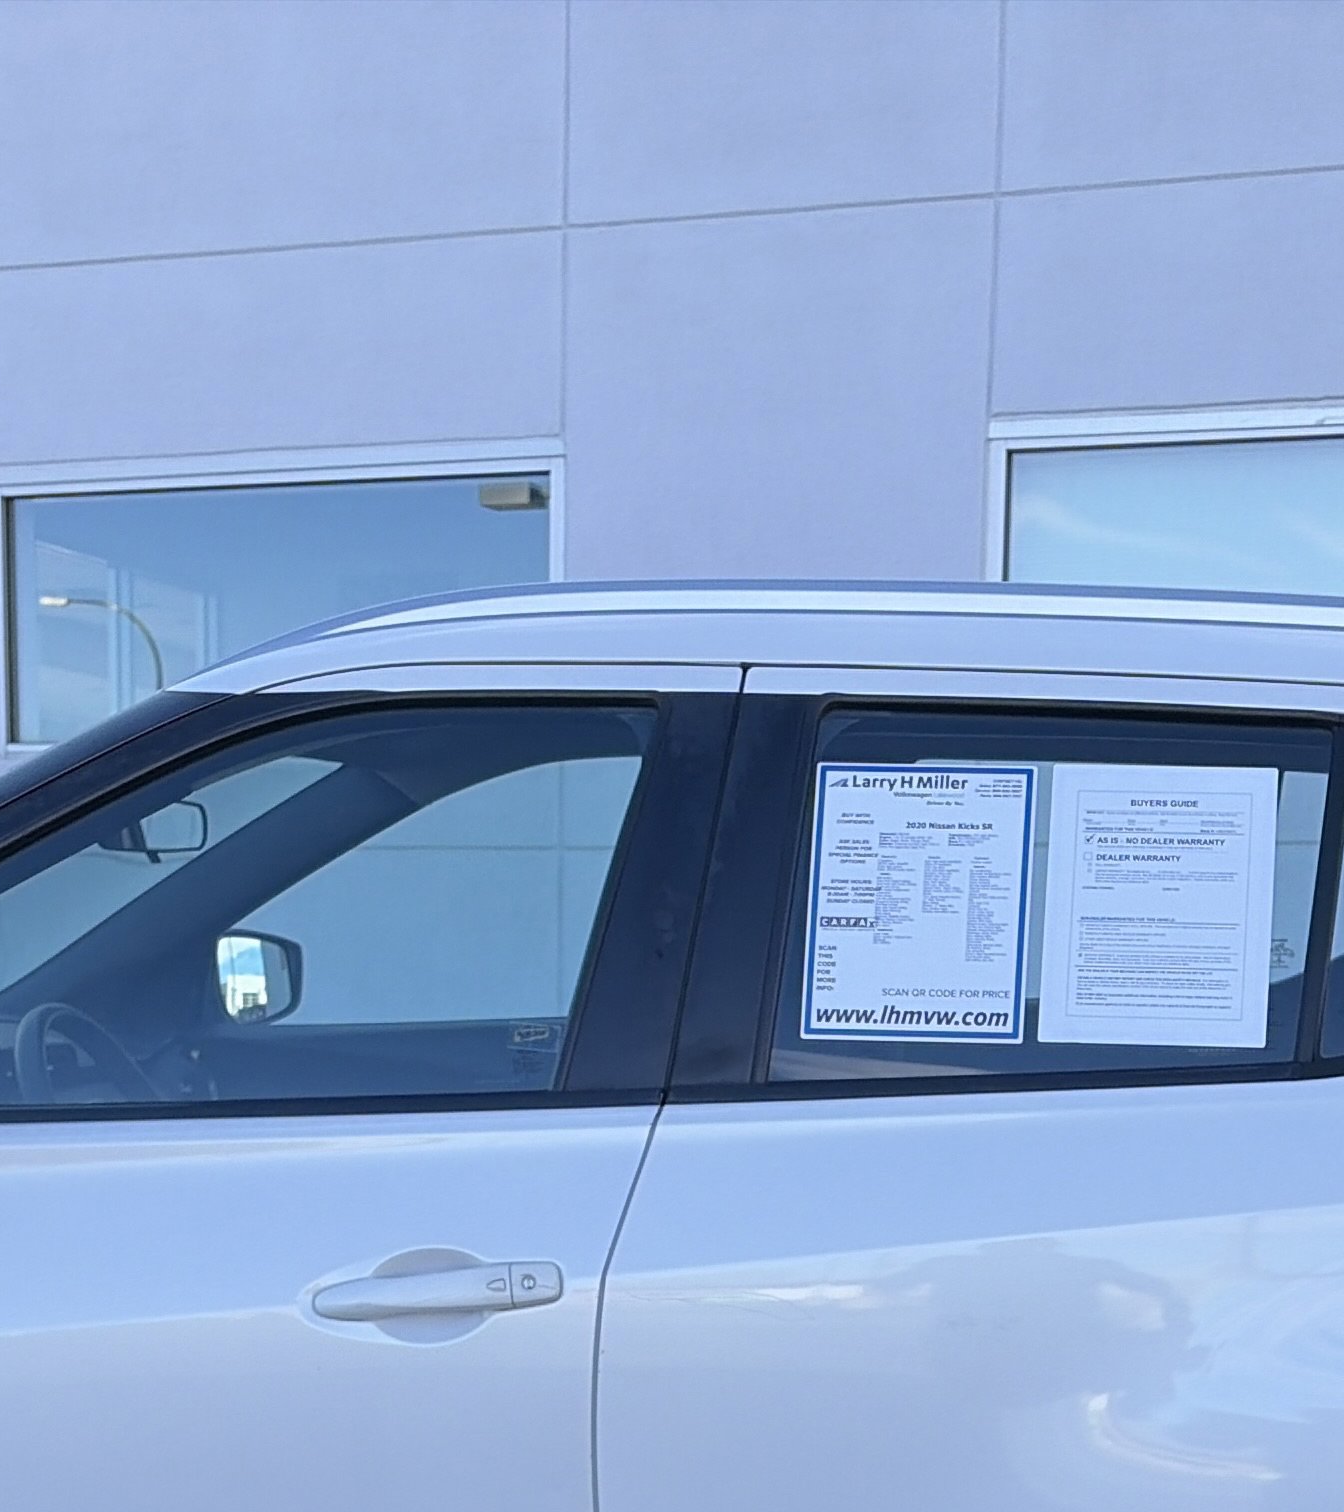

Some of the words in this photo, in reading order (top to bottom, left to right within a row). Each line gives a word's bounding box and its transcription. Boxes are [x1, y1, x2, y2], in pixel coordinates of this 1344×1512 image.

[852, 774, 897, 791] Larry
[901, 776, 914, 788] H
[917, 774, 968, 790] Miller
[1130, 799, 1168, 808] BUYERS
[1170, 800, 1199, 808] GUIDE
[905, 822, 927, 830] 2020
[928, 822, 956, 830] Nissan
[958, 822, 980, 830] Kicks
[981, 823, 993, 831] SR
[1097, 836, 1109, 844] AS
[1110, 837, 1119, 845] IS
[1126, 837, 1139, 845] NO
[1140, 837, 1175, 846] DEALER
[1177, 838, 1225, 847] WARRANTY
[1096, 853, 1131, 862] DEALER
[1132, 854, 1182, 863] WARRANTY
[820, 916, 876, 928] CARFAX
[881, 988, 909, 997] SCAN
[911, 989, 926, 998] QR
[928, 989, 957, 998] CODE
[959, 989, 980, 998] FOR
[982, 990, 1011, 999] PRICE
[816, 1005, 1010, 1027] www.lhmvw.com
